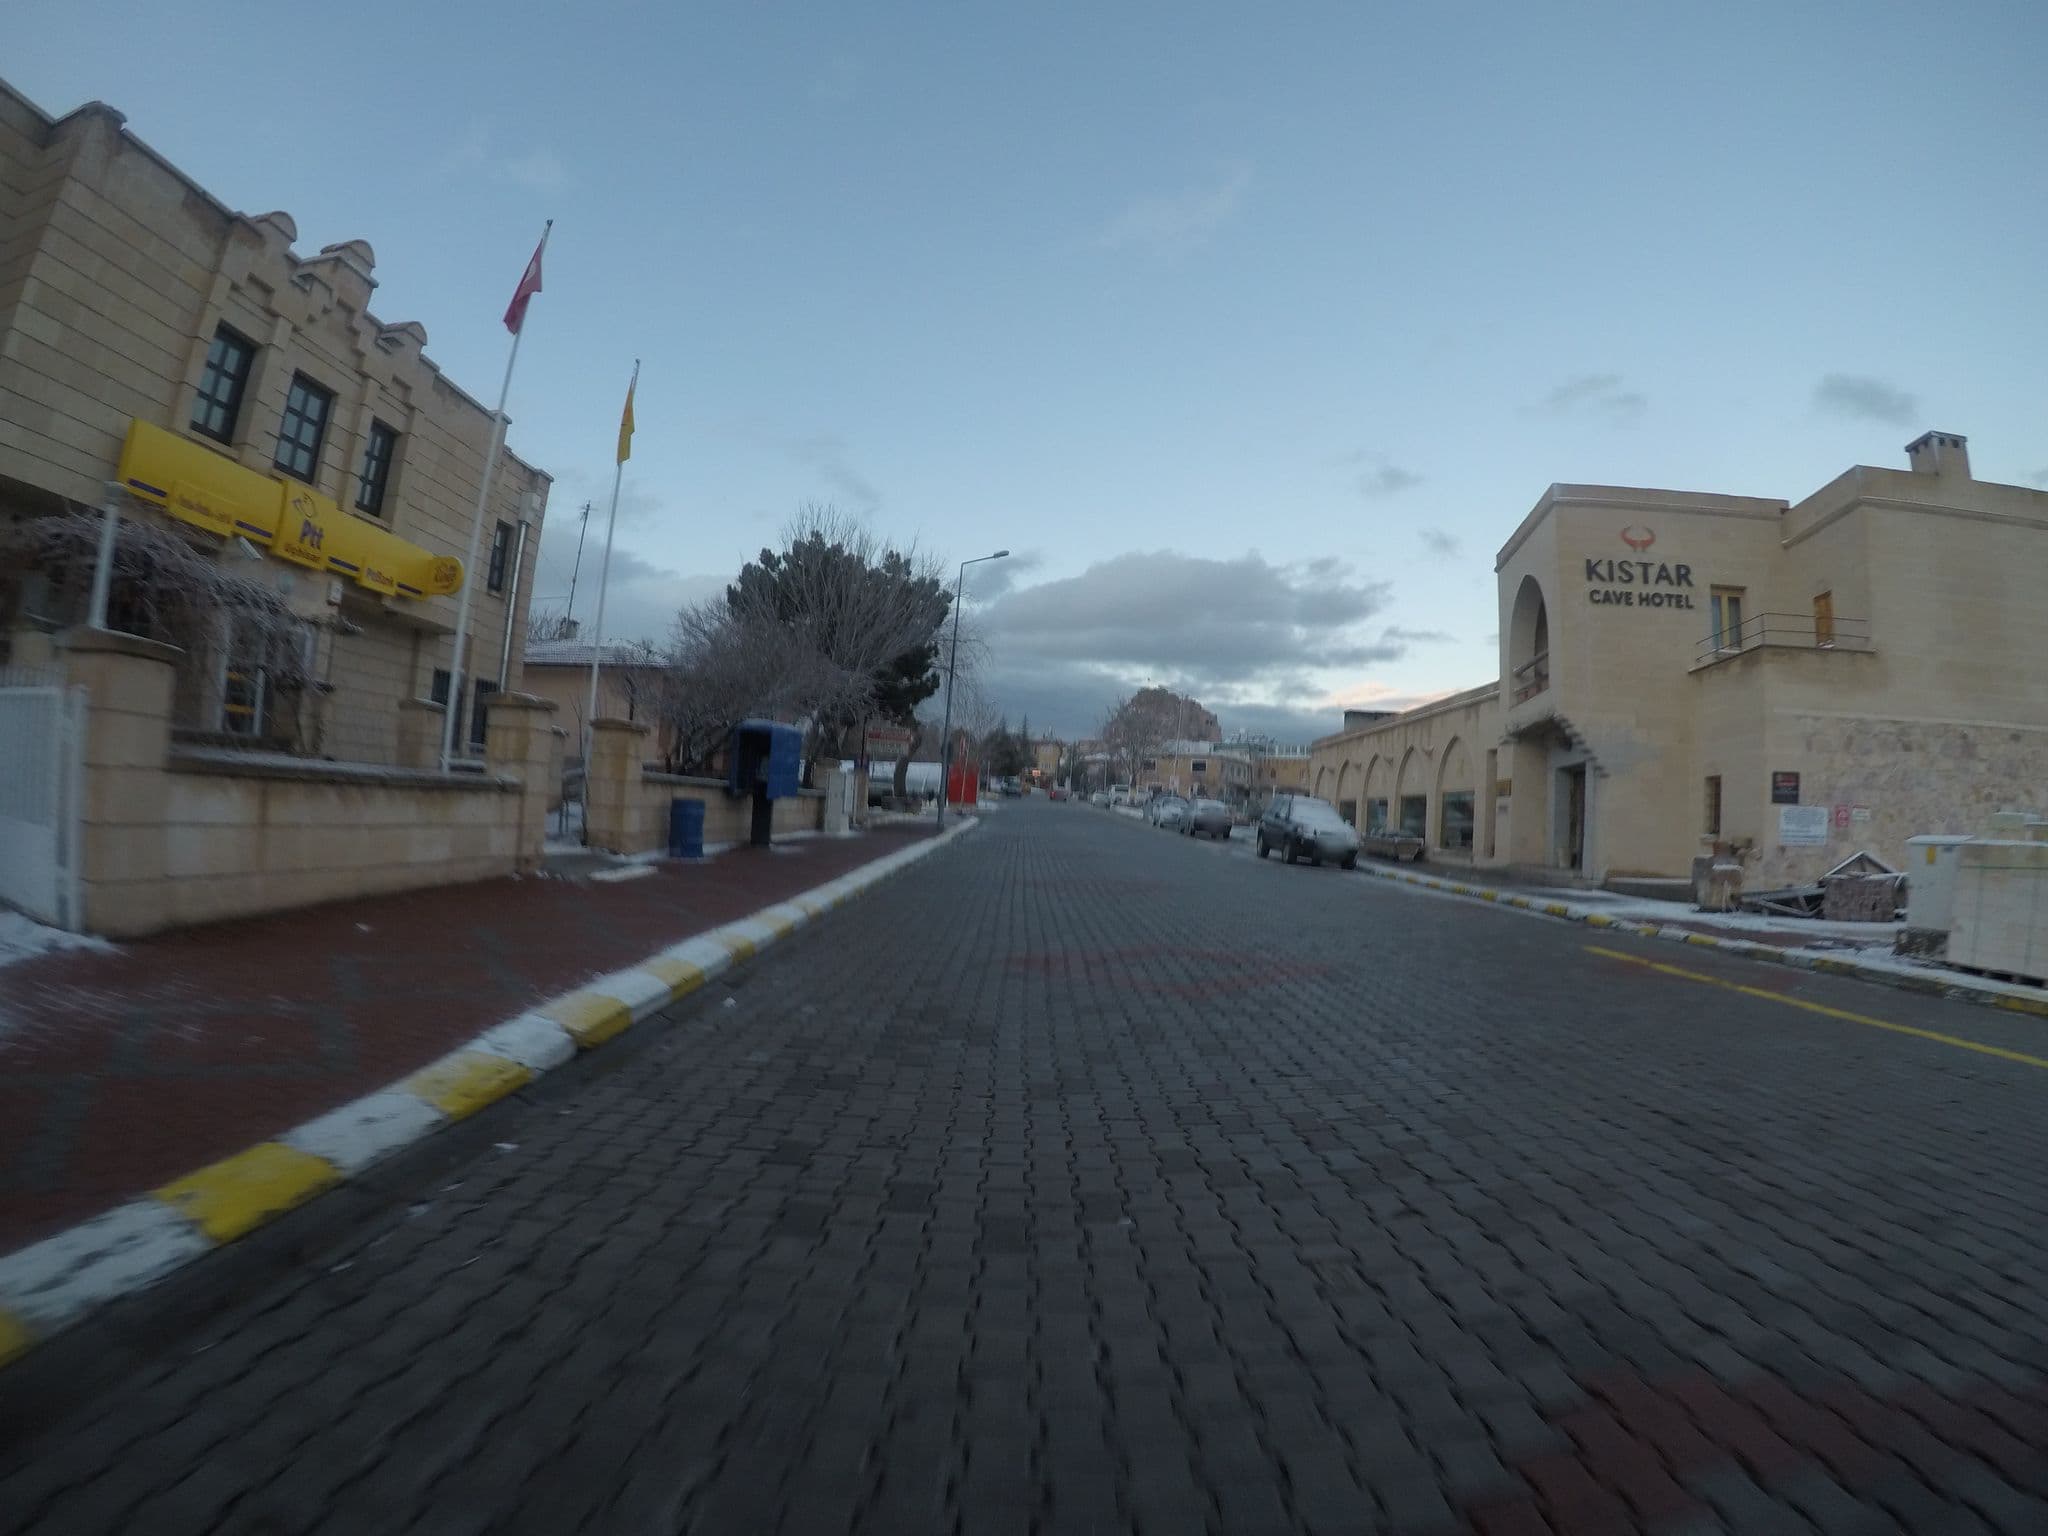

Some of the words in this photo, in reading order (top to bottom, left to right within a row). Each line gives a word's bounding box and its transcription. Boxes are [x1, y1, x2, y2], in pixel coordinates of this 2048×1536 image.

[298, 519, 324, 550] Ptt
[1586, 559, 1694, 587] KISTAR
[1590, 590, 1633, 606] CAVE
[1638, 592, 1694, 609] HOTEL
